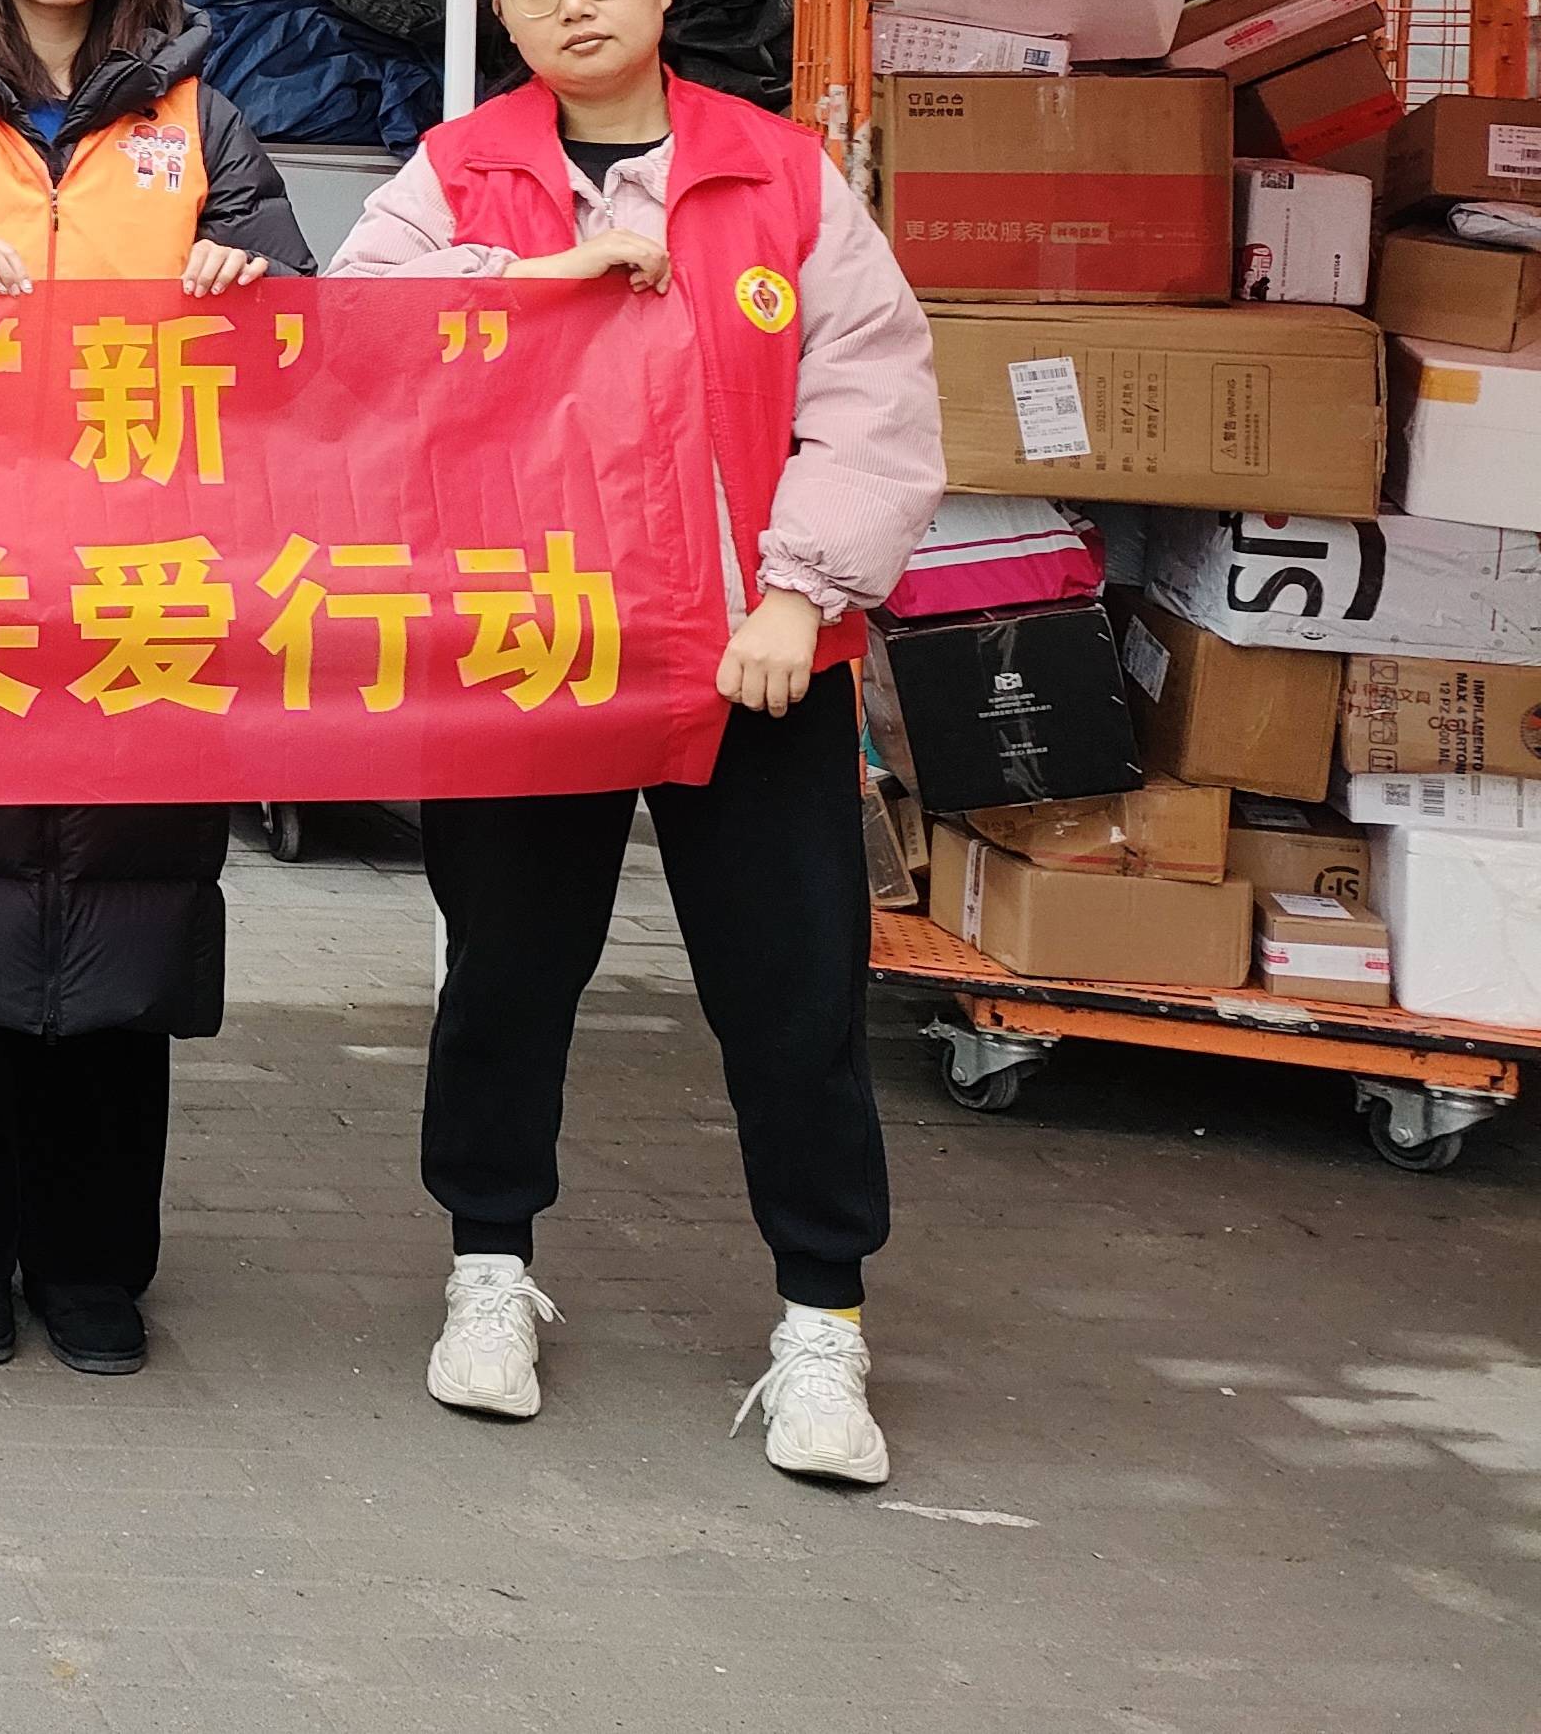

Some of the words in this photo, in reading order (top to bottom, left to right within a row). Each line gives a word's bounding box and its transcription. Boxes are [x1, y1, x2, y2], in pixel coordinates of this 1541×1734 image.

[905, 220, 1047, 243] 更多家政服务
[1439, 681, 1450, 695] 12
[1455, 672, 1468, 703] MAX
[1438, 697, 1450, 714] PZ
[1456, 706, 1466, 714] 4
[1472, 679, 1486, 772] IMPILAMENTO
[1437, 747, 1450, 766] ML
